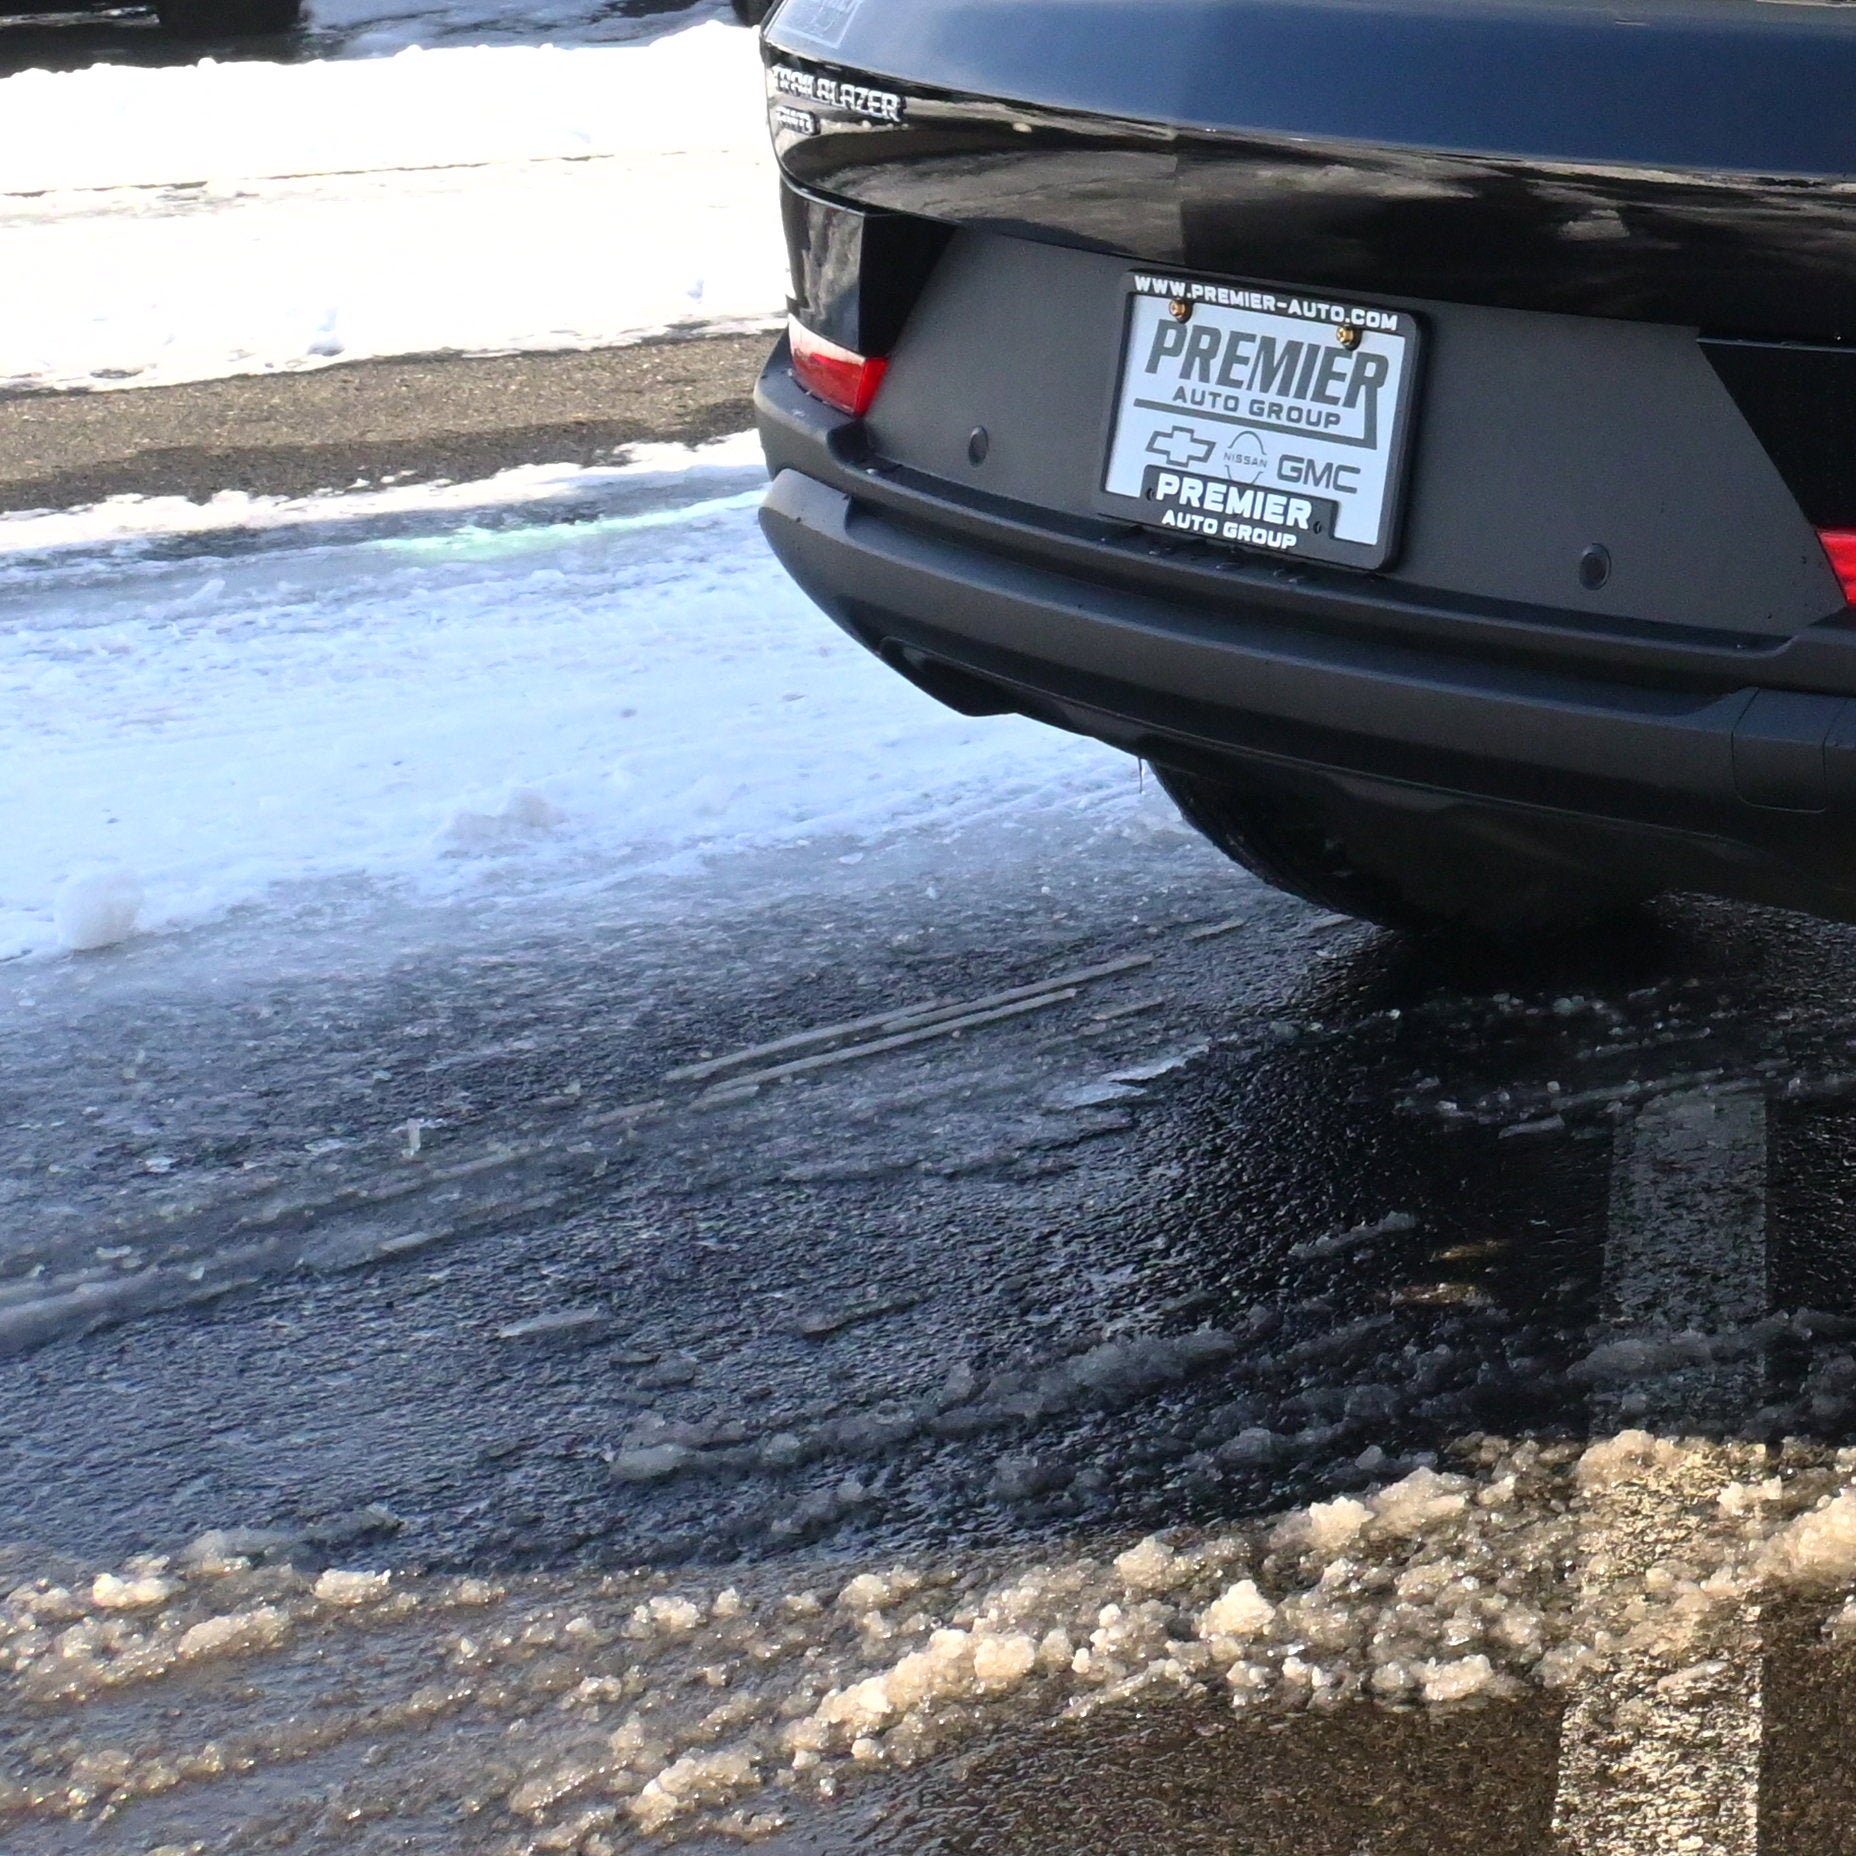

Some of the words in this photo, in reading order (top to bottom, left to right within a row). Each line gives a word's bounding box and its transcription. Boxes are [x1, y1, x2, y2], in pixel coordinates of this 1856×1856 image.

[771, 64, 902, 122] TRAILBLAZER
[1134, 275, 1399, 331] WWW.PREMIER-AUTO.COM
[1145, 318, 1390, 414] PREMIER
[1172, 386, 1240, 412] AUTO
[1249, 398, 1341, 429] GROUP
[1223, 451, 1268, 468] NISSAN
[1276, 454, 1362, 494] GMC
[1156, 473, 1312, 530] PREMIER
[1162, 510, 1218, 536] AUTO
[1223, 521, 1298, 549] GROUP
